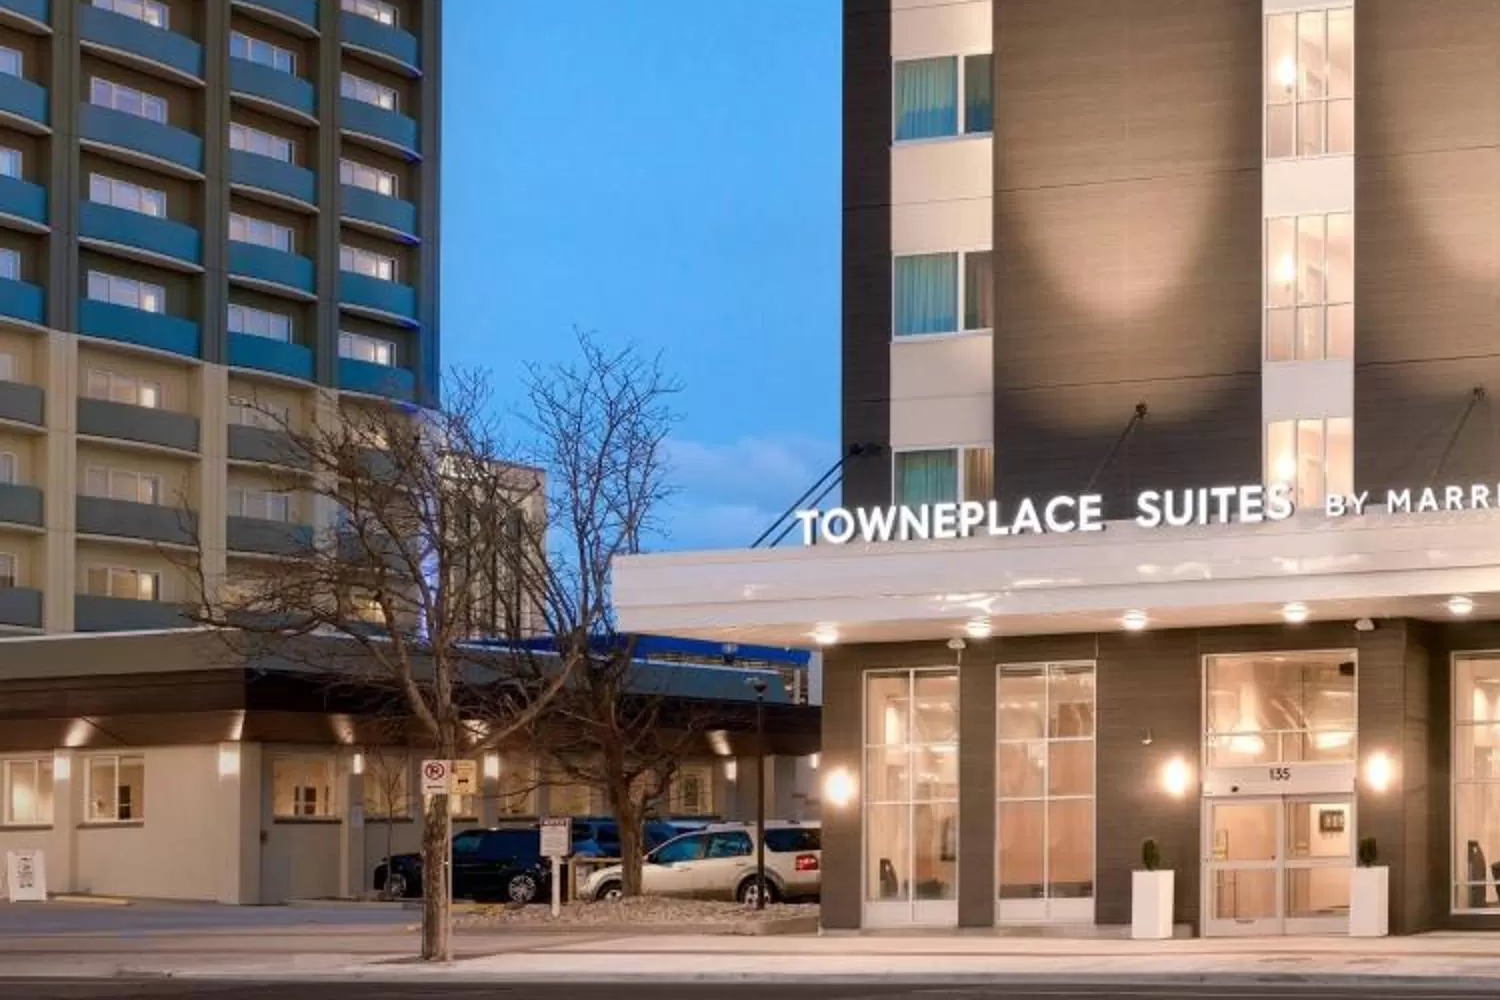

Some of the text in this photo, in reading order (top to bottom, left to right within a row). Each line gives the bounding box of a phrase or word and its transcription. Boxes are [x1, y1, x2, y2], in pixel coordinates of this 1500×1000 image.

[796, 494, 1105, 546] TOWNEPLACE
[1136, 483, 1297, 528] SUITES
[1325, 491, 1368, 517] BY
[1269, 767, 1291, 781] 135
